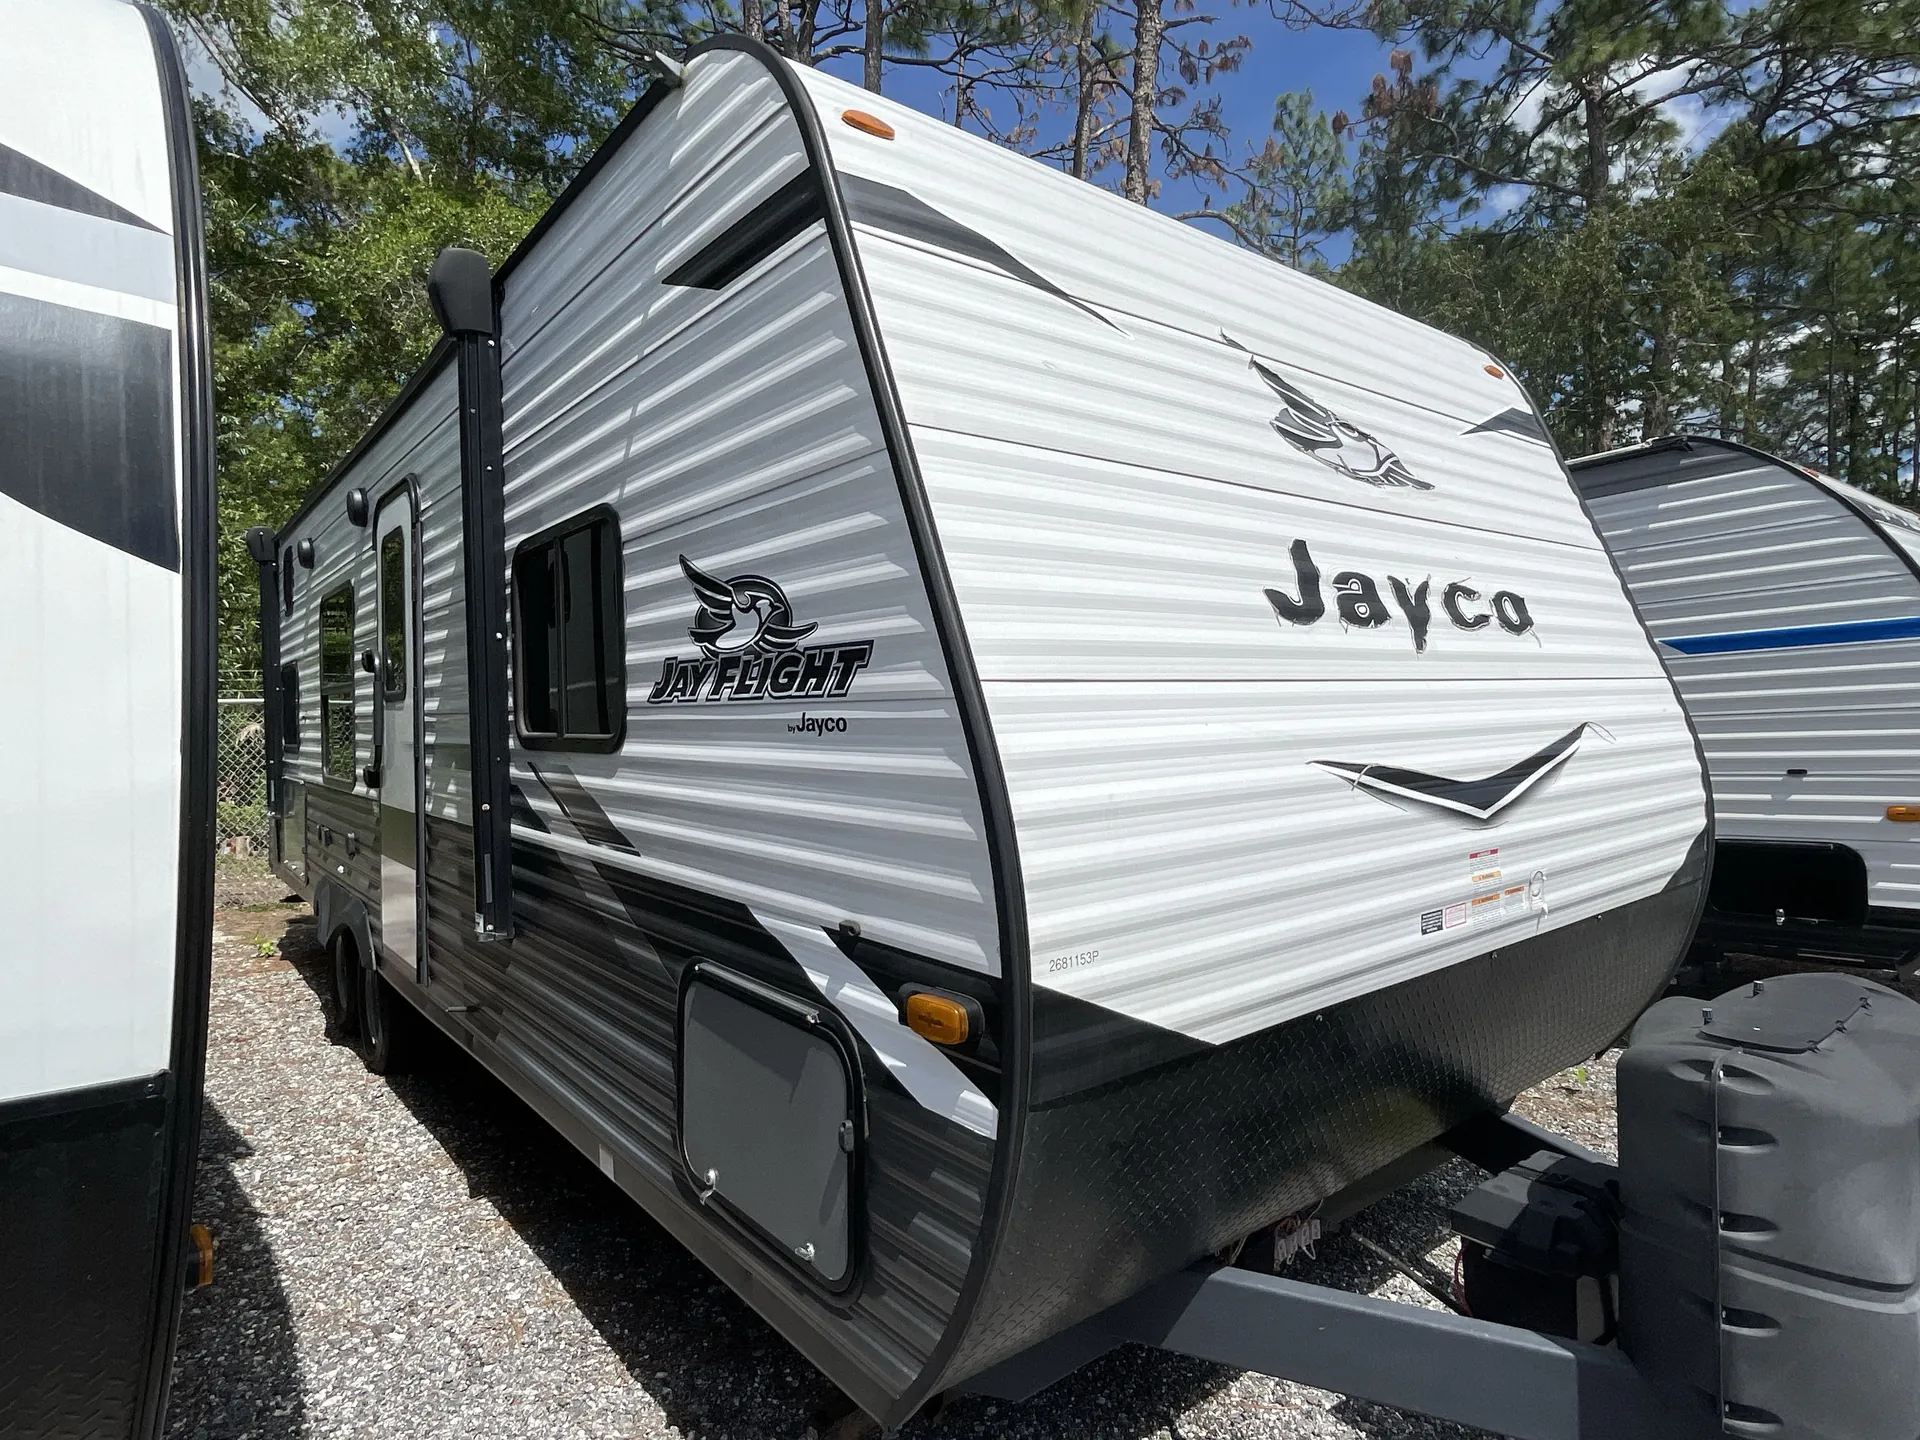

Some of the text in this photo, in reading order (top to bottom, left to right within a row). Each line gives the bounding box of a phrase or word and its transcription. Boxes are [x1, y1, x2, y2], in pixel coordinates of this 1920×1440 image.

[1263, 538, 1535, 655] Jayco
[647, 639, 876, 704] JAY FLIGHT
[787, 712, 848, 737] by Jayco
[1049, 950, 1100, 973] 2681153P
